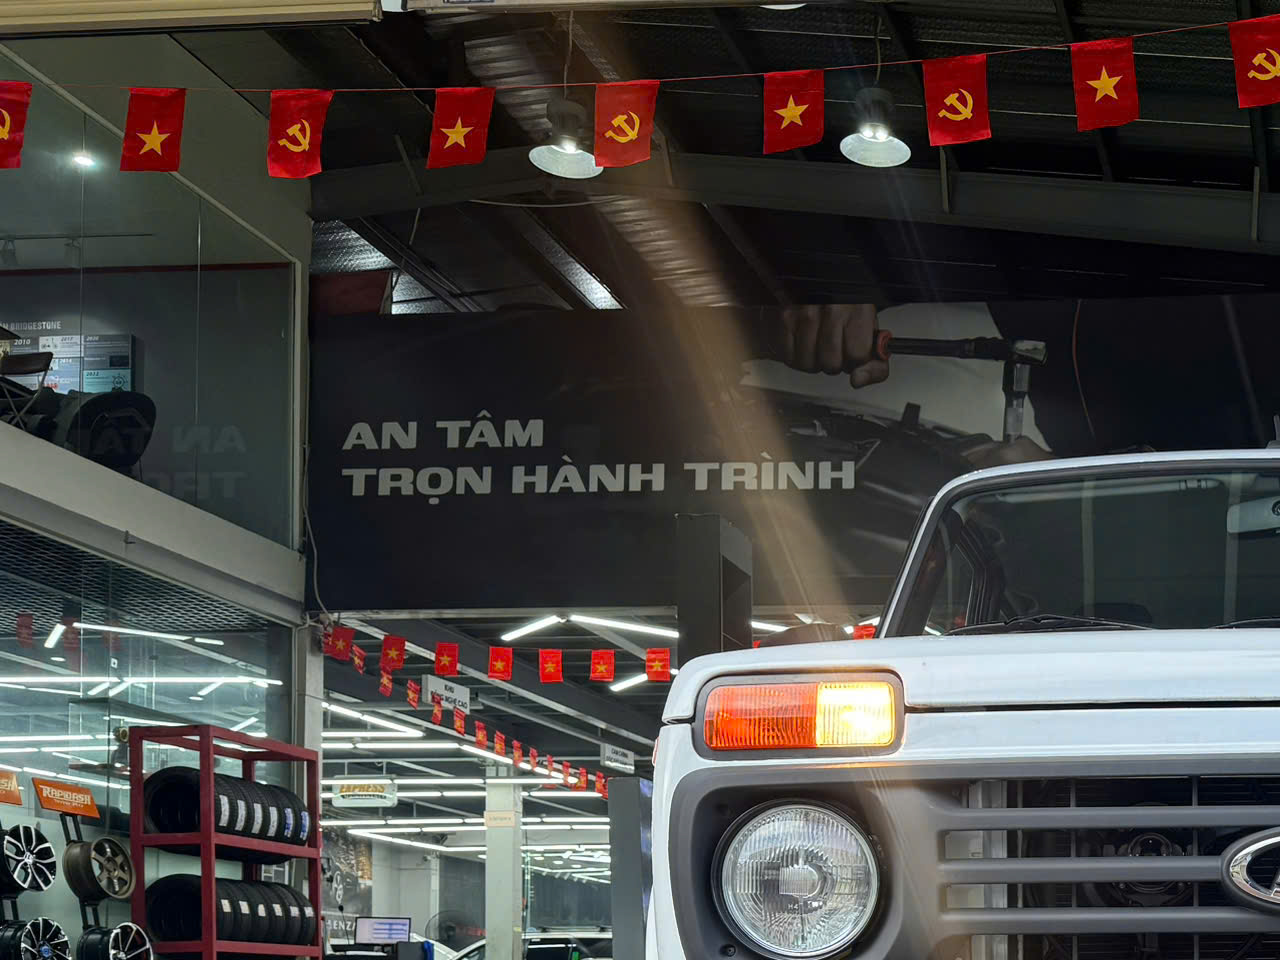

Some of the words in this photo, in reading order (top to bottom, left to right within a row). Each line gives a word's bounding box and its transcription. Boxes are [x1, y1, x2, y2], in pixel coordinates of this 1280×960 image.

[10, 320, 62, 331] BRIDGESTONE
[14, 338, 31, 346] 2010
[342, 421, 417, 450] AN
[435, 409, 544, 448] TÂM
[342, 466, 492, 505] TRỌN
[512, 455, 665, 494] HÀNH
[684, 451, 856, 491] TRÌNH
[39, 784, 91, 805] RAPIDASH
